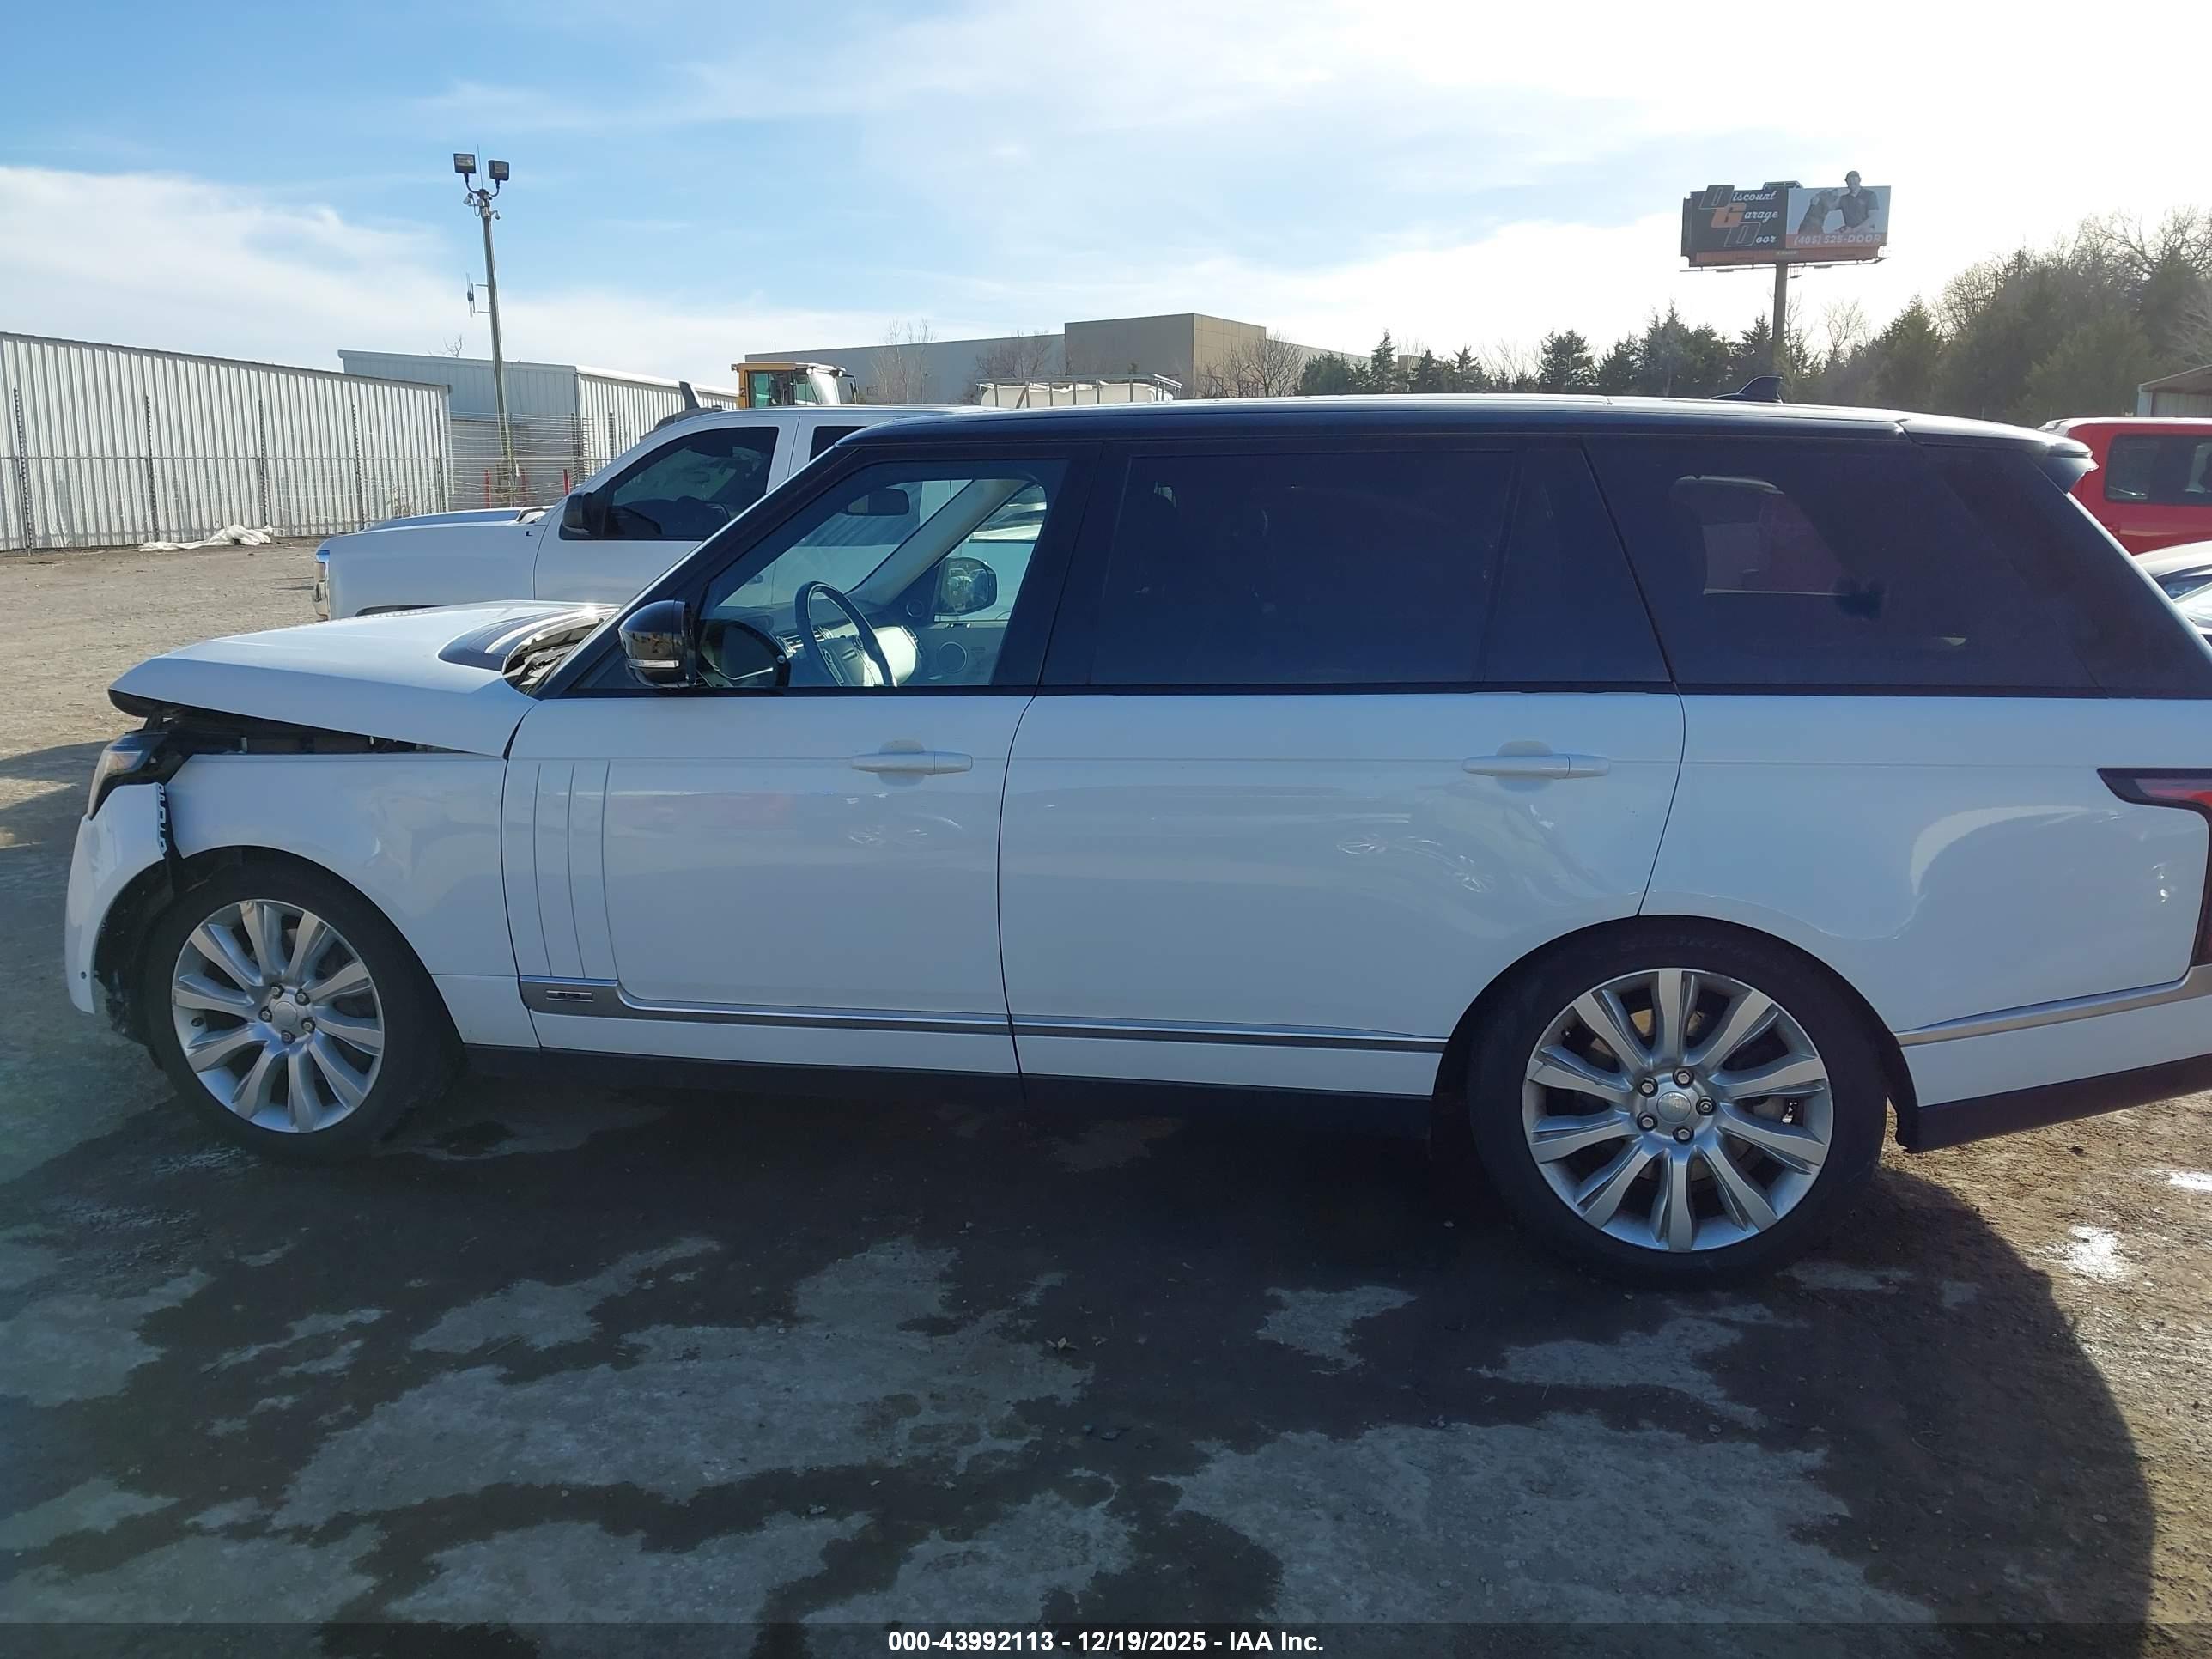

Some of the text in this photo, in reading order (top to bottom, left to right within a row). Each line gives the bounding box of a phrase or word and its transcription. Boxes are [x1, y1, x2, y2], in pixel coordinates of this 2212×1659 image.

[1698, 185, 1778, 210] Discount
[1711, 203, 1778, 228] Garage
[1724, 222, 1777, 247] Door
